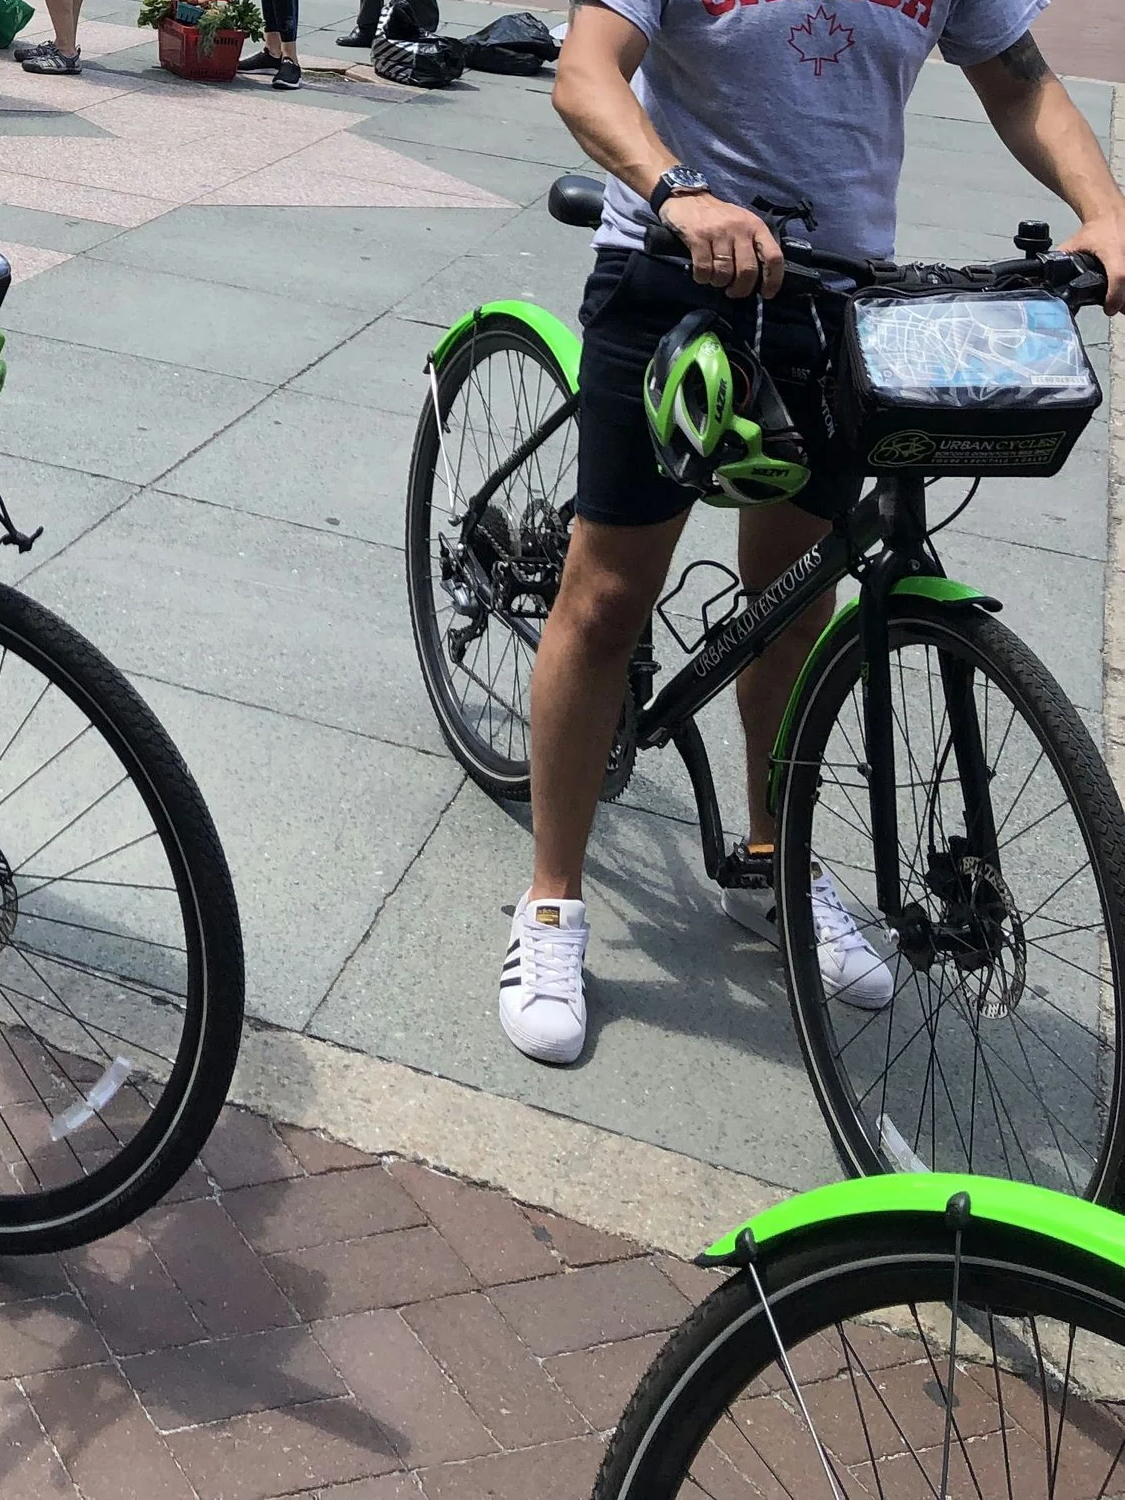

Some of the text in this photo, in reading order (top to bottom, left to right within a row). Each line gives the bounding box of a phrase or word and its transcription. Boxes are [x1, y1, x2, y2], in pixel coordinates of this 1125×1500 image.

[715, 377, 728, 424] LAZER
[939, 437, 1059, 451] URBAN CYCLES
[694, 543, 822, 677] URBAN ADVENTOURS
